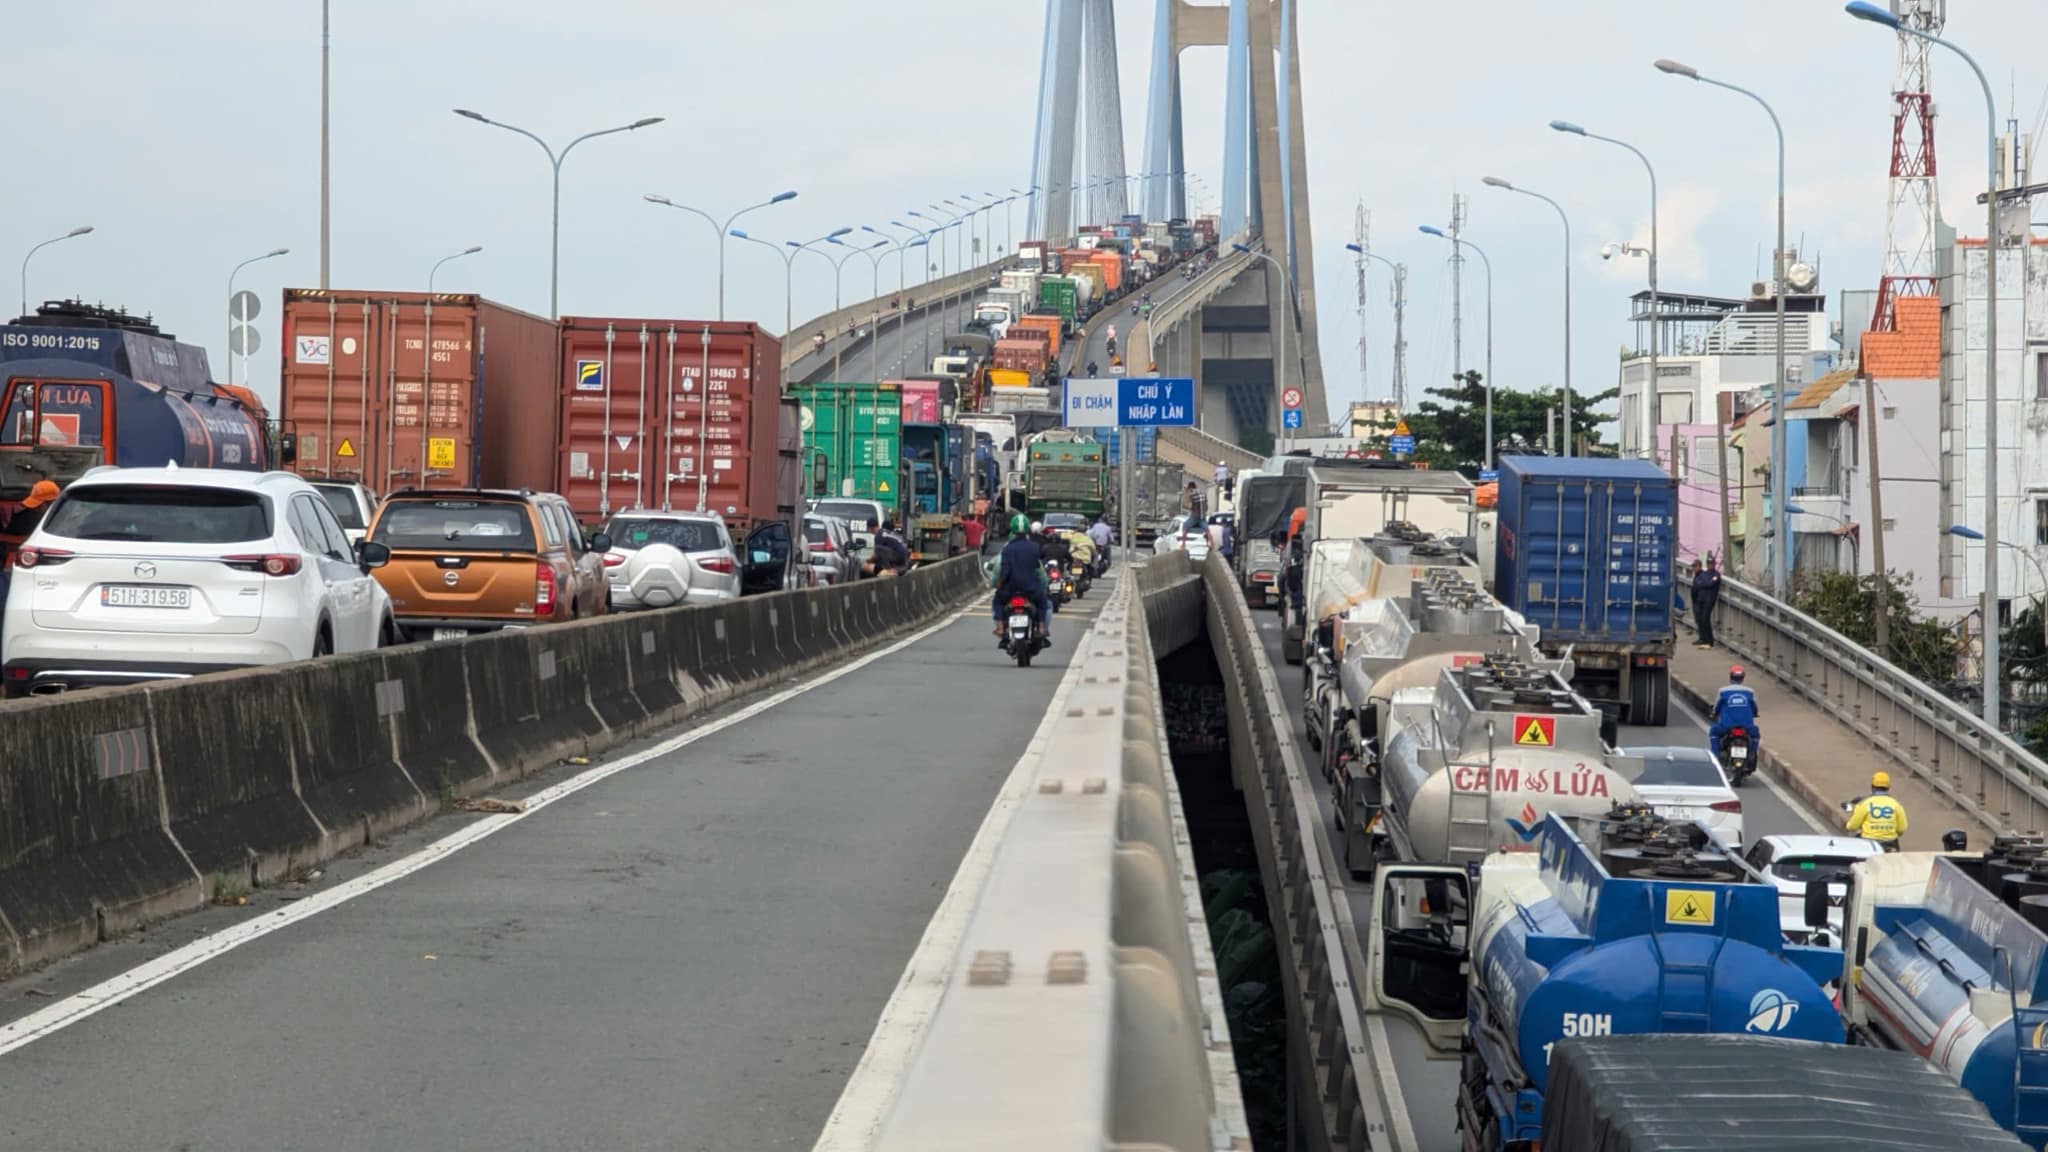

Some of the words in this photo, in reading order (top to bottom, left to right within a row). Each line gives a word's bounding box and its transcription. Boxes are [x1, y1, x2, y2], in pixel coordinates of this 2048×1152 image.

[3, 333, 28, 347] ISO
[31, 334, 100, 350] 9001:2015
[1138, 383, 1159, 399] CHÚ
[1165, 382, 1173, 399] Ý
[1072, 396, 1082, 409] ĐI
[1085, 394, 1113, 411] CHẬM
[1128, 403, 1157, 422] NHẬP
[1161, 402, 1183, 420] LÀN
[111, 588, 187, 606] 51H-319.58
[1455, 766, 1519, 792] CAM
[1553, 762, 1609, 798] LỬA
[1869, 801, 1894, 819] be
[1562, 1012, 1612, 1037] 50H
